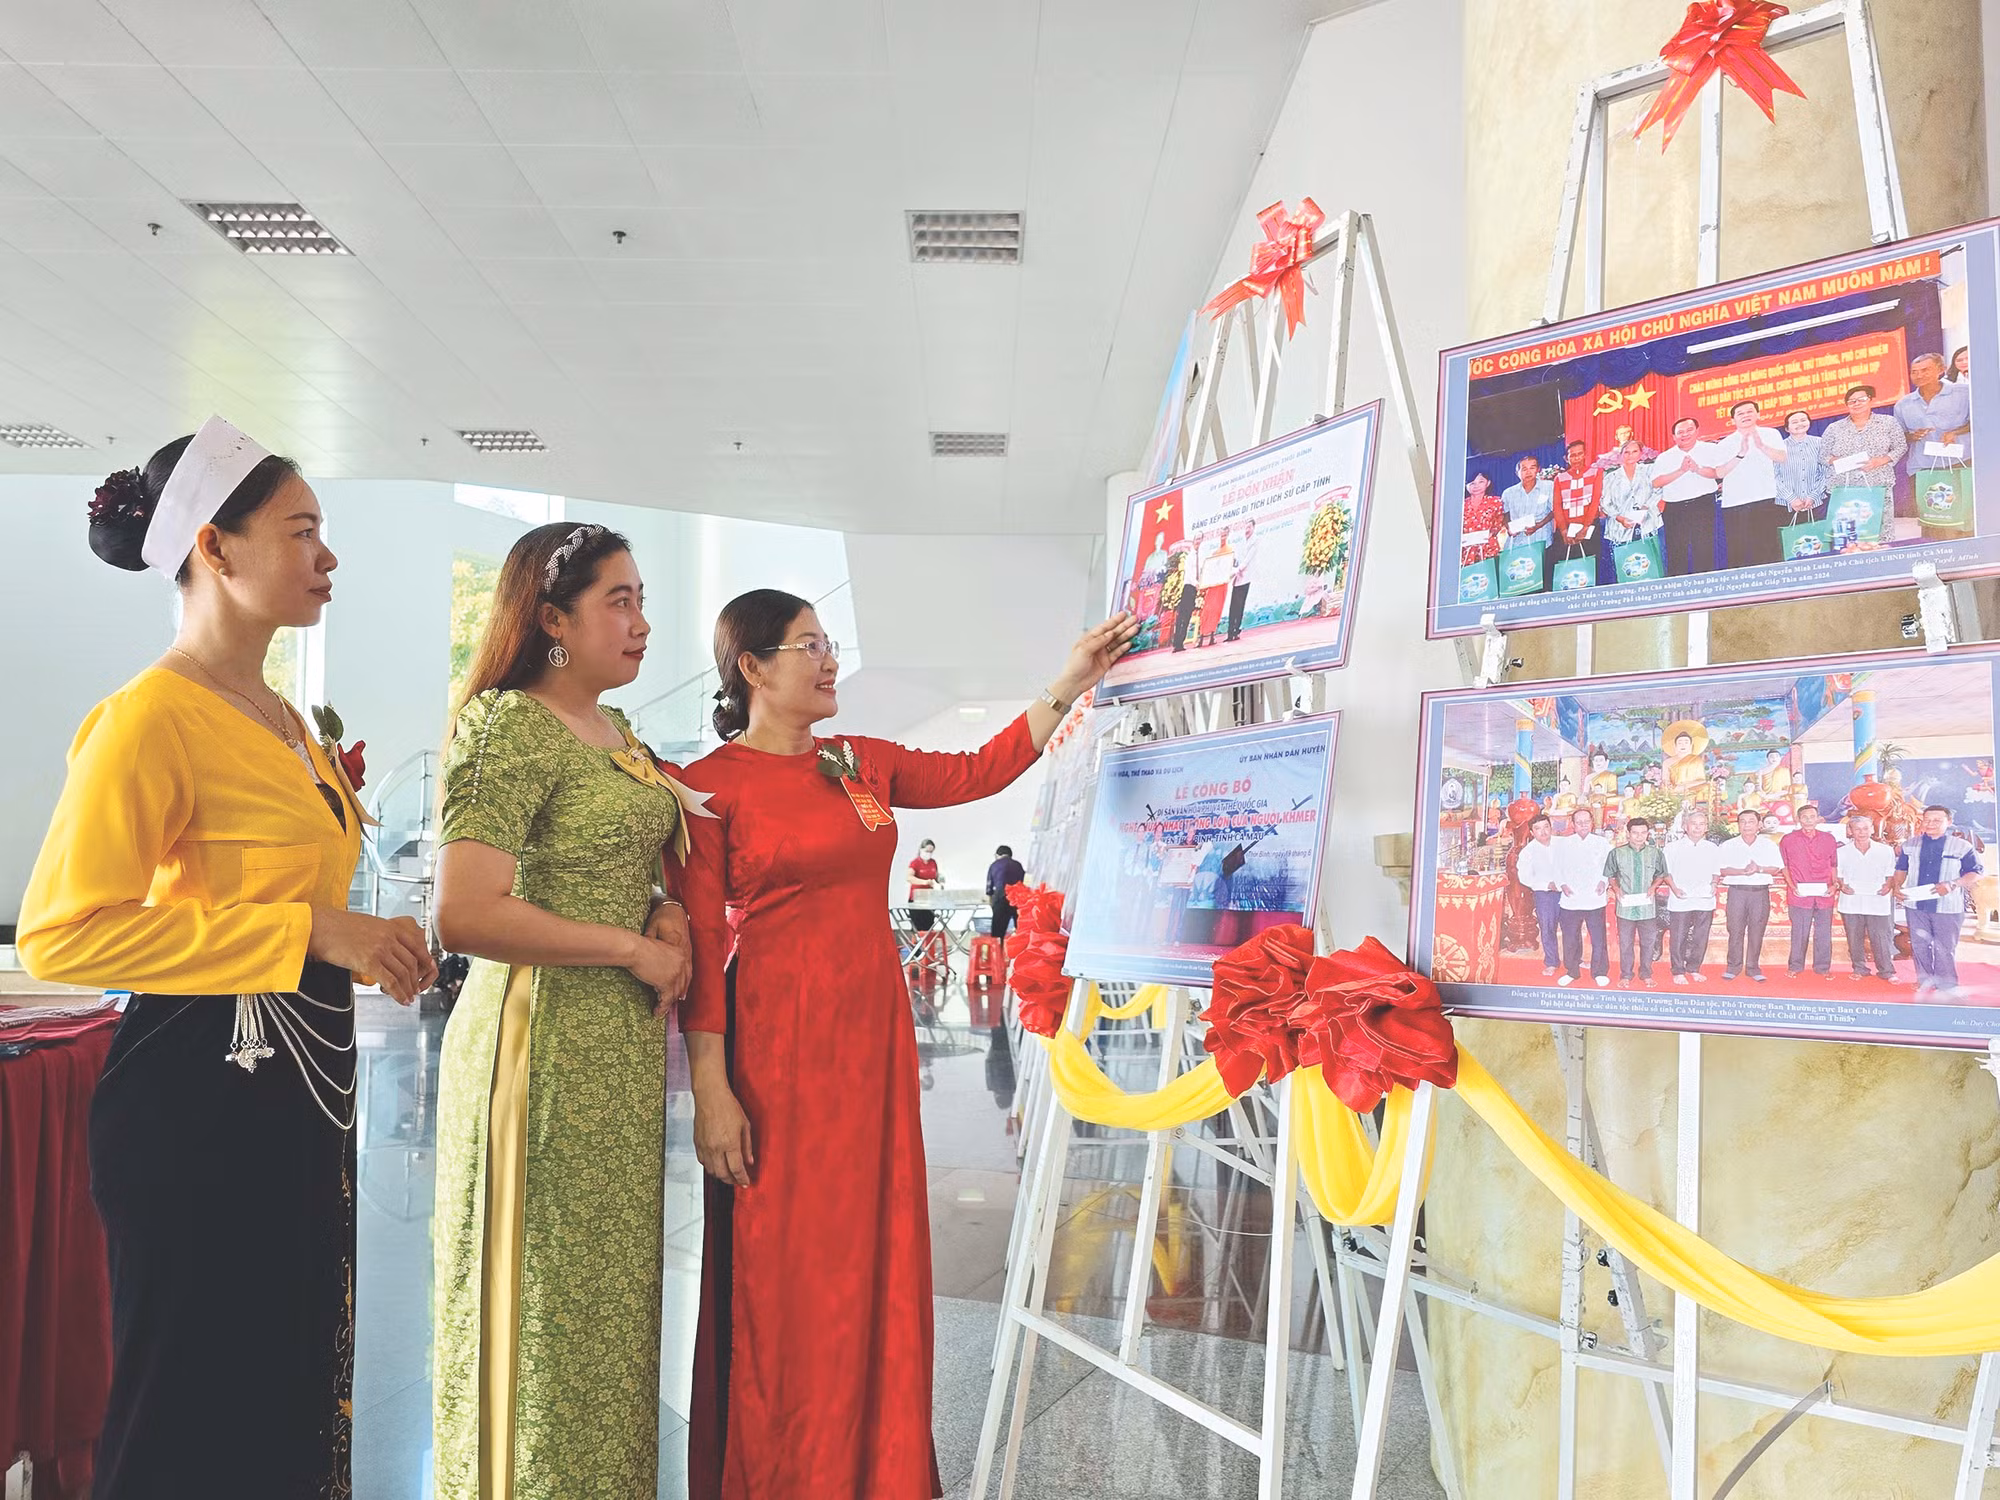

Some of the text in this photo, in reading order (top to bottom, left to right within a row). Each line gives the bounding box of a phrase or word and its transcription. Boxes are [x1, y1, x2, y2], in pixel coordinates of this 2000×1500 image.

[1498, 343, 1541, 370] CỘNG
[1546, 339, 1577, 359] HÒA
[1582, 331, 1604, 351] XÃ
[1609, 325, 1637, 345] HỘI
[1641, 313, 1675, 337] CHỦ
[1679, 303, 1731, 329] NGHĨA
[1734, 294, 1773, 315] VIỆT
[1778, 284, 1817, 306] NAM
[1822, 271, 1875, 296] MUÔN
[1880, 259, 1922, 283] NĂM
[1192, 779, 1229, 798] CÔNG
[1282, 808, 1317, 824] KHMER
